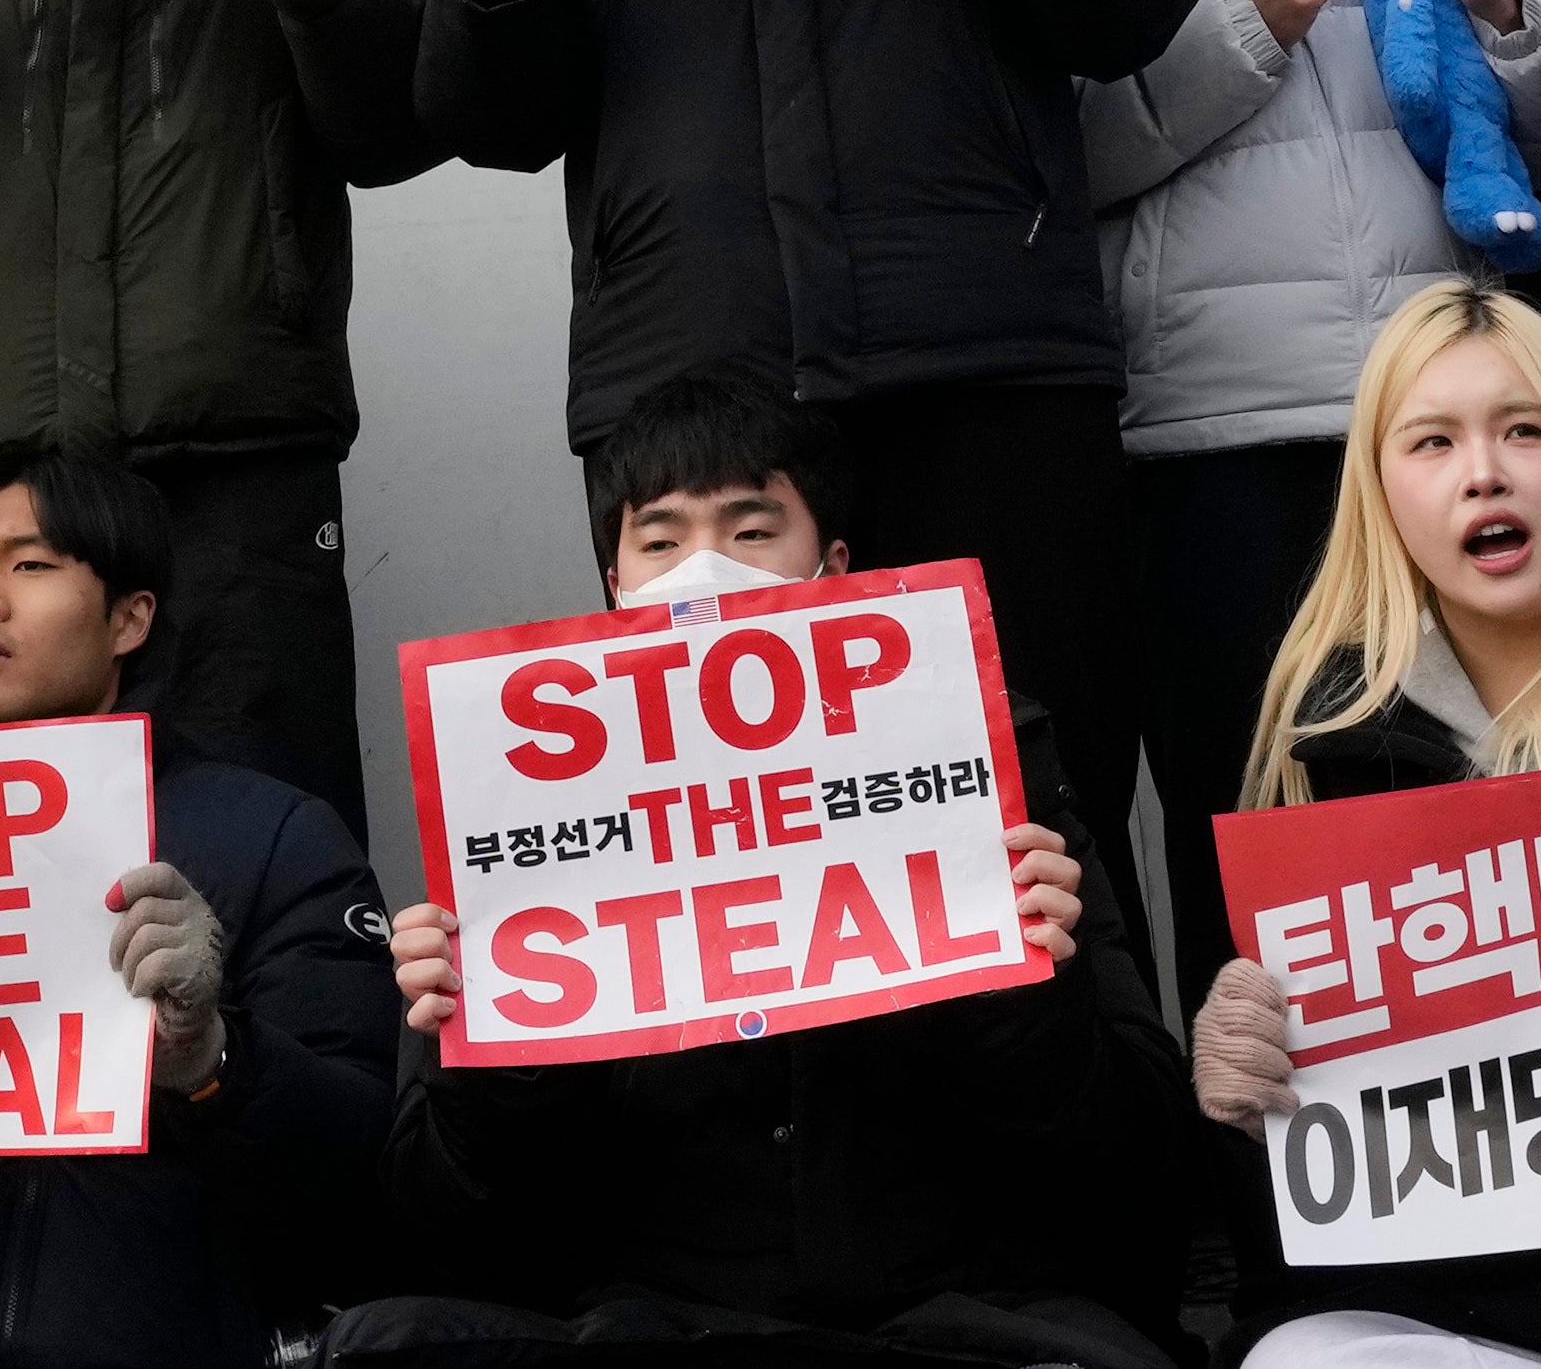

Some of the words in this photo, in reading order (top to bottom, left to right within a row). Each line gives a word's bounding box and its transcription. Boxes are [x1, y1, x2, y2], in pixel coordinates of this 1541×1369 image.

[499, 612, 912, 782] STOP
[628, 767, 823, 865] THE
[821, 757, 992, 823] 검증하라
[464, 813, 634, 875] 부정선거
[490, 850, 1003, 1030] STEAL
